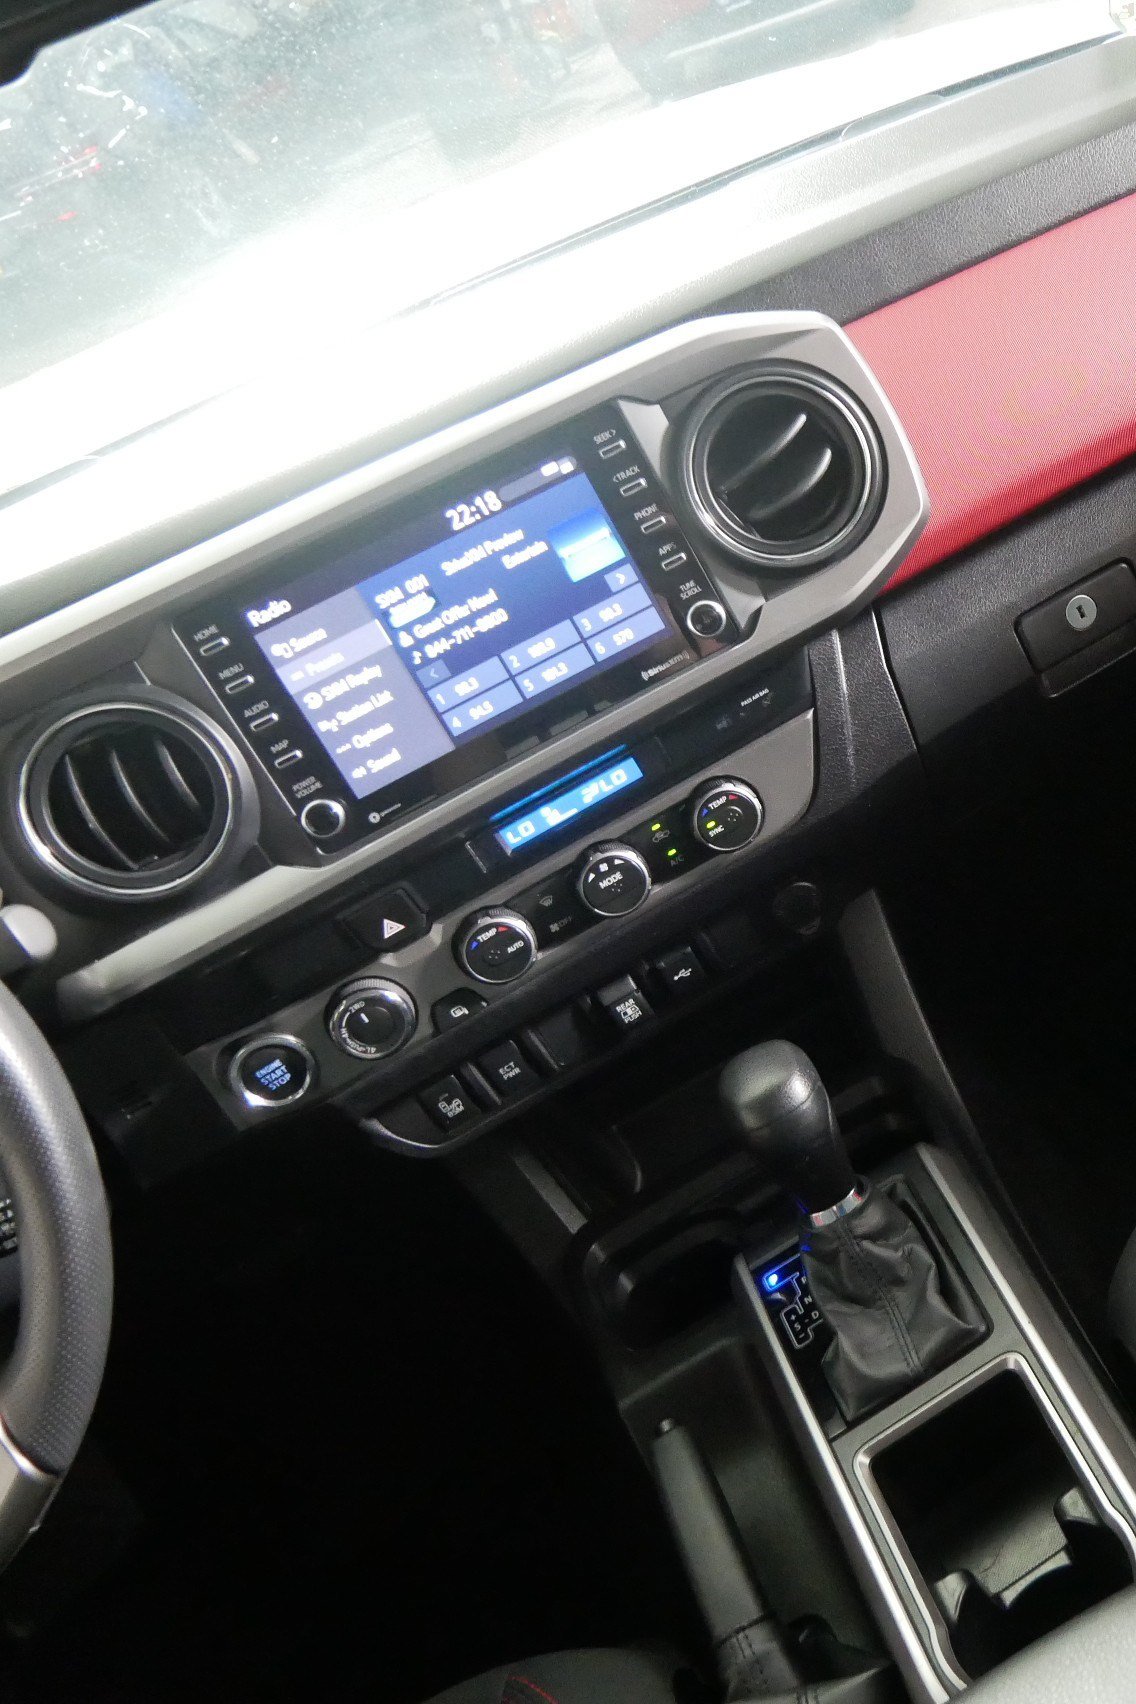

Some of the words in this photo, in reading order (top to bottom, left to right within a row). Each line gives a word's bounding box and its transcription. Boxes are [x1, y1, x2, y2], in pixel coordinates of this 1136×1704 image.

[594, 431, 612, 445] SEEK
[445, 490, 502, 531] 22:18
[633, 503, 658, 521] PHONE
[658, 541, 677, 556] APPS
[679, 579, 696, 592] TUNE
[680, 586, 702, 600] SCROLL
[246, 599, 292, 628] Radio
[581, 618, 592, 632] 3
[194, 624, 219, 642] HOME
[509, 656, 520, 669] 2
[218, 662, 244, 680] MENU
[523, 679, 534, 692] 5
[243, 700, 269, 718] AUDIO
[352, 722, 394, 749] Options
[270, 739, 290, 754] MAP
[292, 775, 316, 792] POWER
[599, 768, 628, 792] LO
[295, 783, 324, 799] VOLUME
[707, 795, 727, 810] TEMP
[506, 820, 535, 845] LO
[708, 824, 725, 838] SYNC
[599, 871, 624, 889] MODE
[476, 927, 498, 943] TEMP
[507, 940, 525, 954] AUTO
[616, 998, 636, 1013] REAR
[624, 1010, 642, 1024] PUSH
[255, 1058, 283, 1078] ENGINE
[260, 1065, 289, 1086] START
[499, 1061, 516, 1075] ECT
[503, 1067, 521, 1080] PWR
[268, 1072, 292, 1091] STOP
[804, 1295, 813, 1304] N
[811, 1310, 819, 1320] D
[794, 1322, 802, 1331] S
